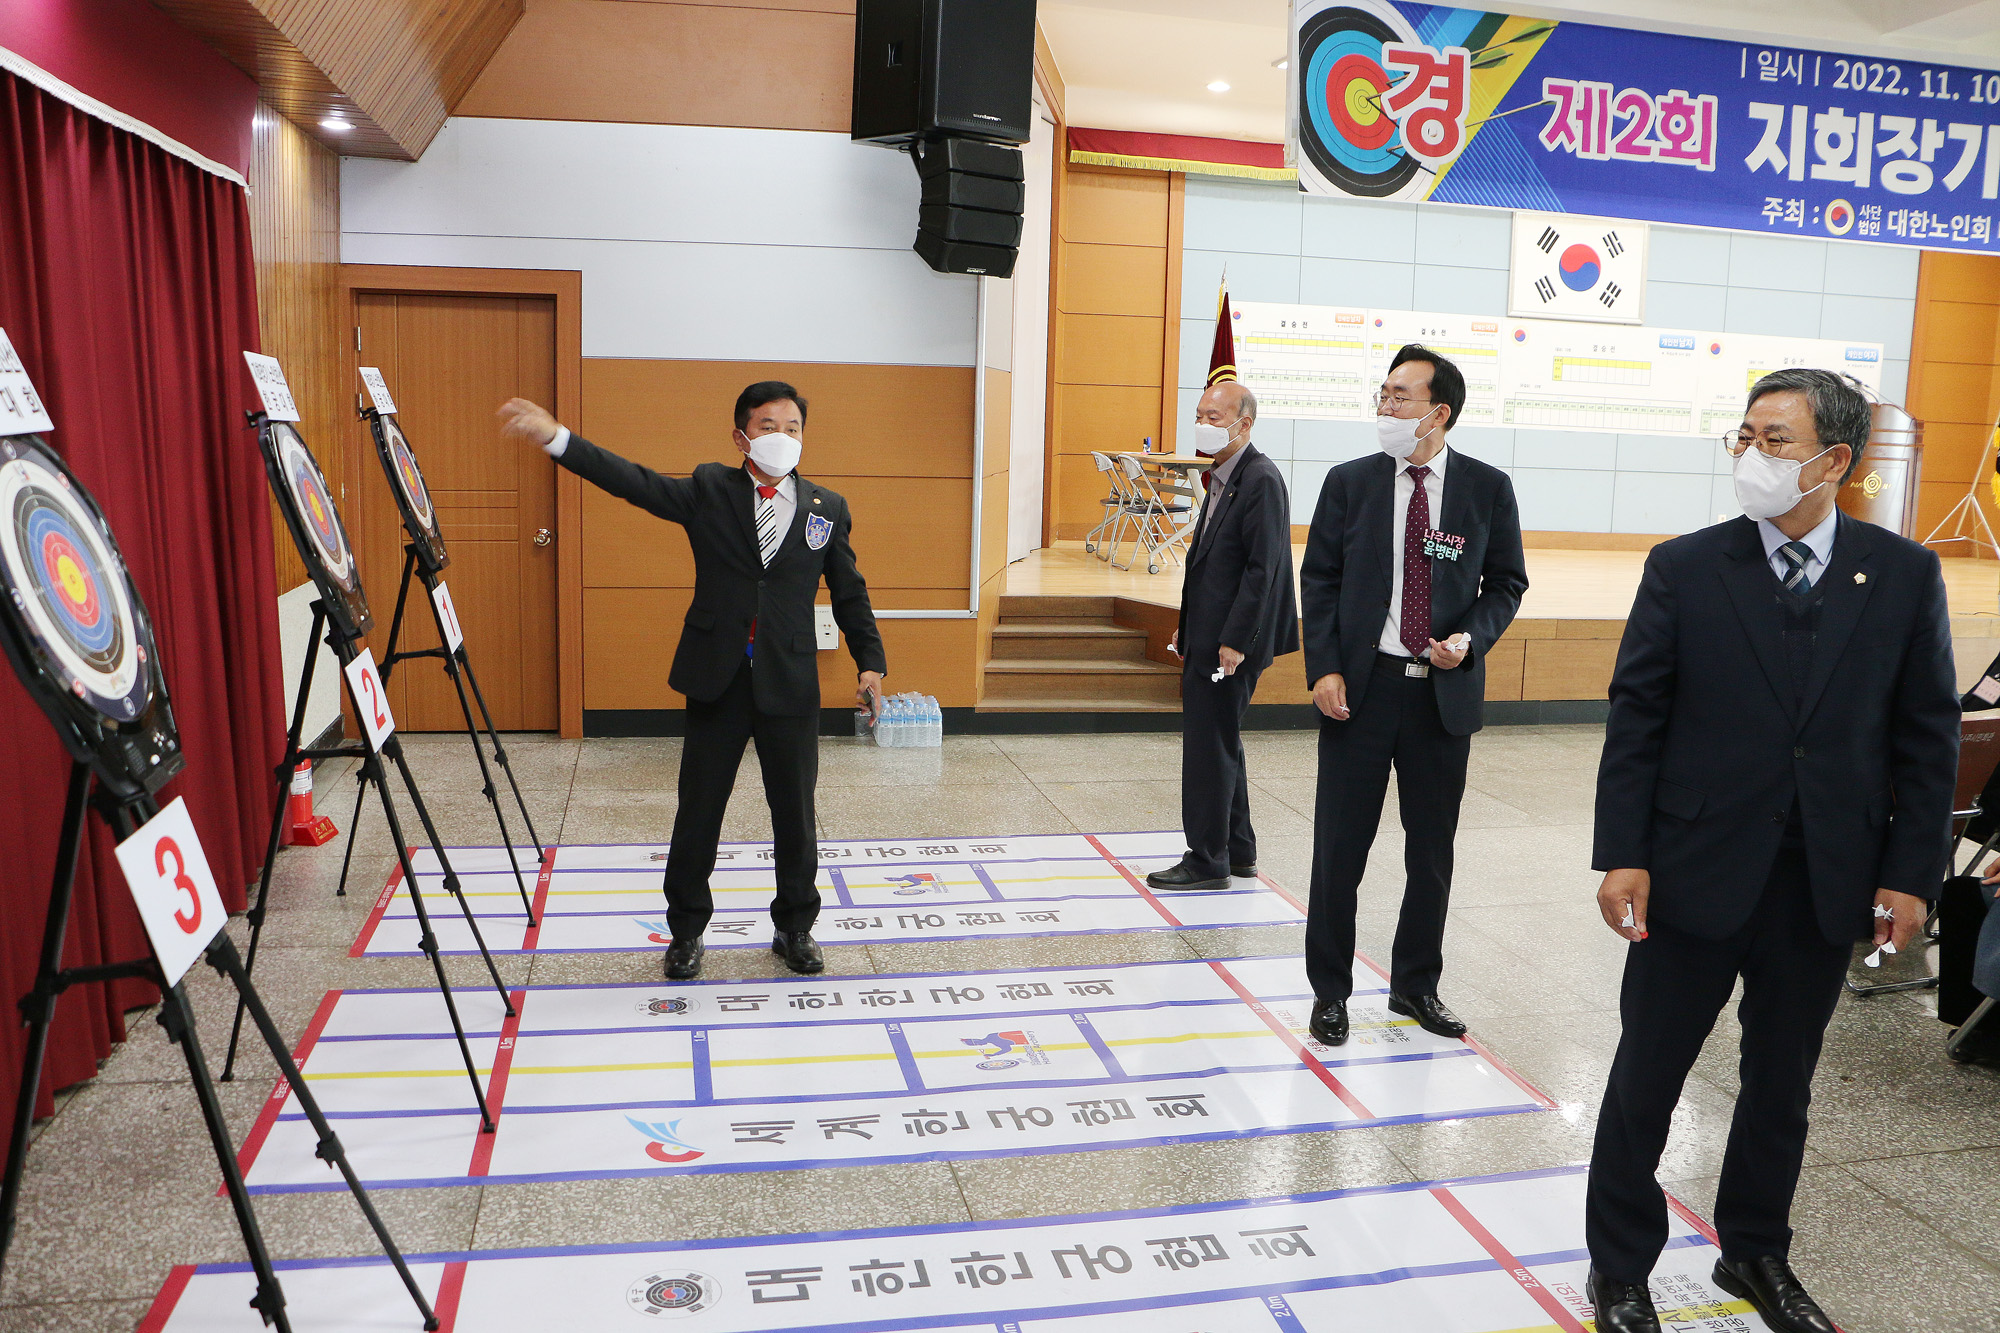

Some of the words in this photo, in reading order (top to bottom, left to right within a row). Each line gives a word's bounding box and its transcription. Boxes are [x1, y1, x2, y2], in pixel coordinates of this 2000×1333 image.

[1757, 50, 1804, 85] 일시
[1832, 59, 1910, 96] 2022.
[1919, 69, 1960, 101] 11.
[1384, 45, 1468, 161] 경
[1542, 81, 1715, 168] 제2회
[1744, 102, 2000, 200] 지회장기
[1858, 219, 1881, 236] 법인
[1859, 204, 1882, 221] 사단
[1887, 208, 1992, 244] 대한노인회
[1423, 540, 1459, 561] 윤병태
[1424, 528, 1466, 550] 나주시장
[442, 594, 456, 637] 1
[361, 667, 386, 732] 2
[154, 835, 202, 935] 3
